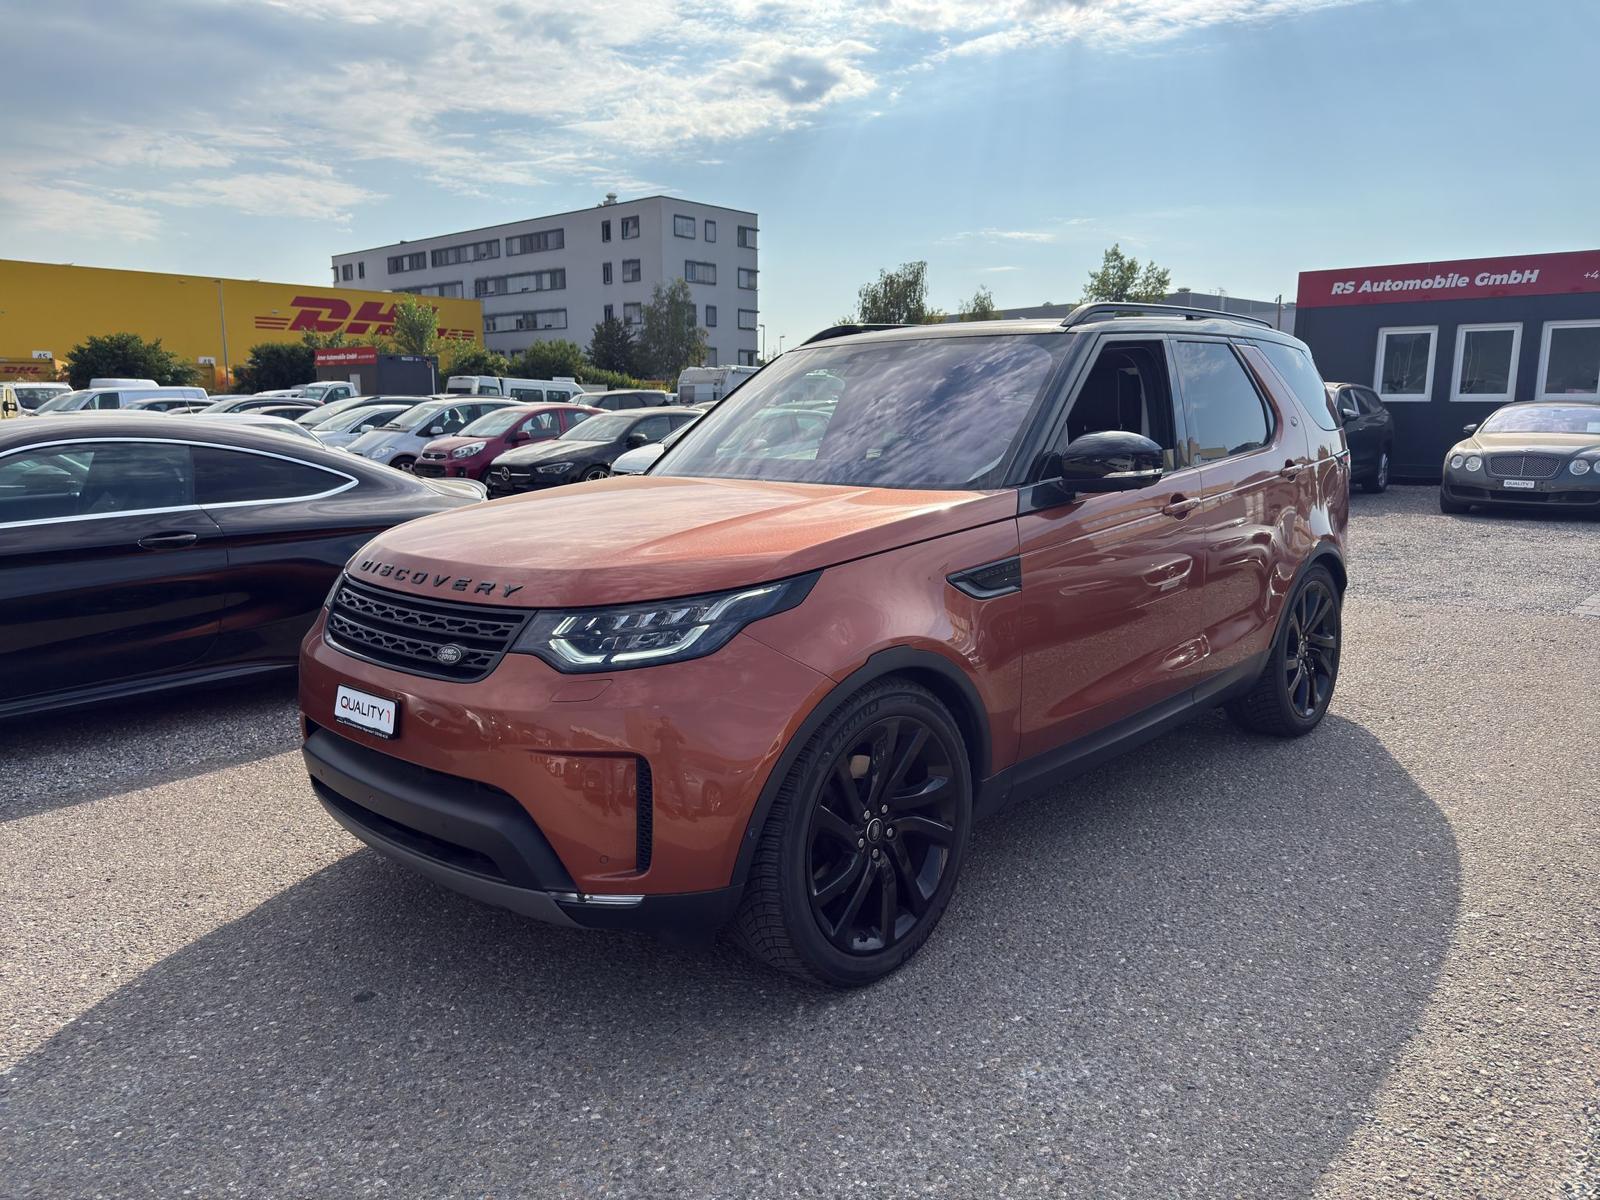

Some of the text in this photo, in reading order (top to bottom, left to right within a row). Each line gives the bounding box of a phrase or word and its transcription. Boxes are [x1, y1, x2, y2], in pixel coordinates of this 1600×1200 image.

[1331, 269, 1540, 295] RS Automobile GmbH
[4, 366, 42, 374] DHL
[359, 559, 526, 598] DISCOVERY
[340, 695, 391, 724] QUALITY 1
